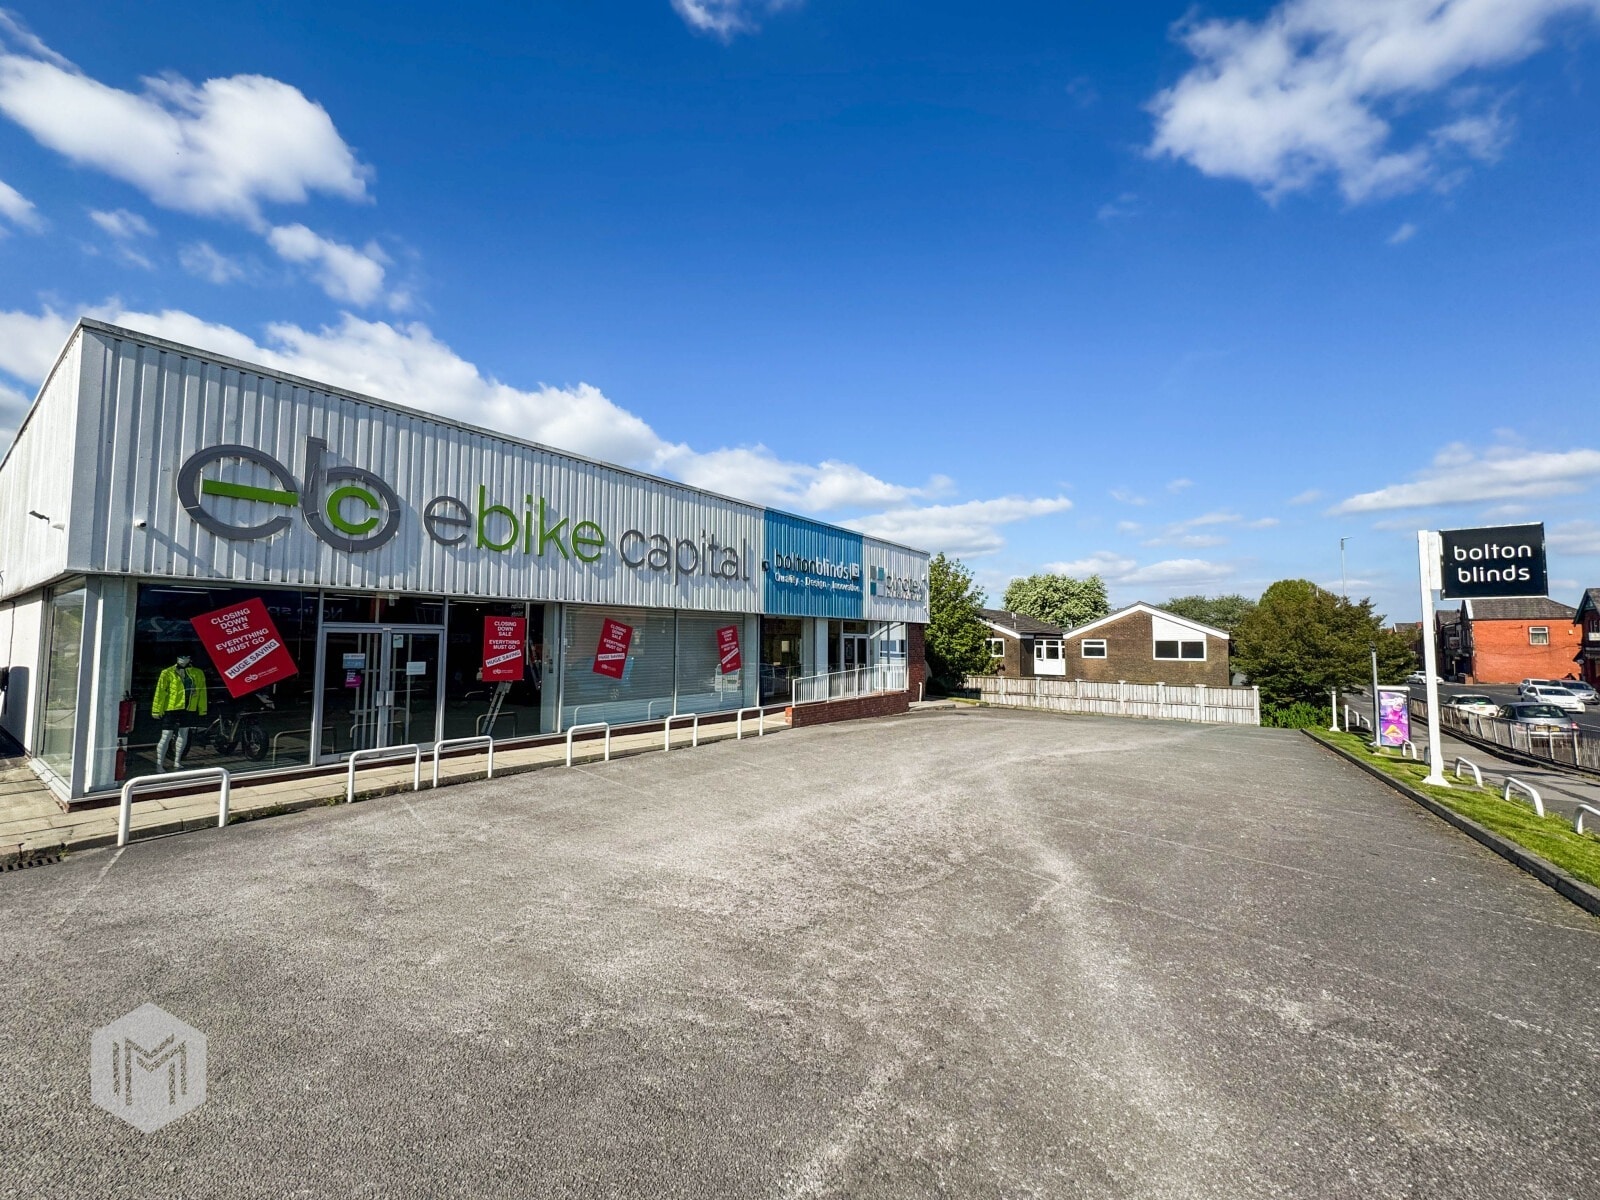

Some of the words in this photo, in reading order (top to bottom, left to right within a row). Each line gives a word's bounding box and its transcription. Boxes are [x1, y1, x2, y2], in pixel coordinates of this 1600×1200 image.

[619, 529, 750, 586] capital
[1454, 543, 1532, 561] bolton
[1458, 564, 1531, 583] blinds
[211, 608, 251, 625] CLOSING
[220, 616, 248, 630] DOWN
[226, 622, 250, 635] SALE
[216, 628, 269, 651] EVERYTHING
[226, 642, 250, 654] MUST
[252, 636, 265, 645] GO
[227, 659, 252, 677] HUGE
[250, 641, 277, 661] SAVING
[486, 657, 502, 666] HUGE
[502, 650, 521, 660] SAVING
